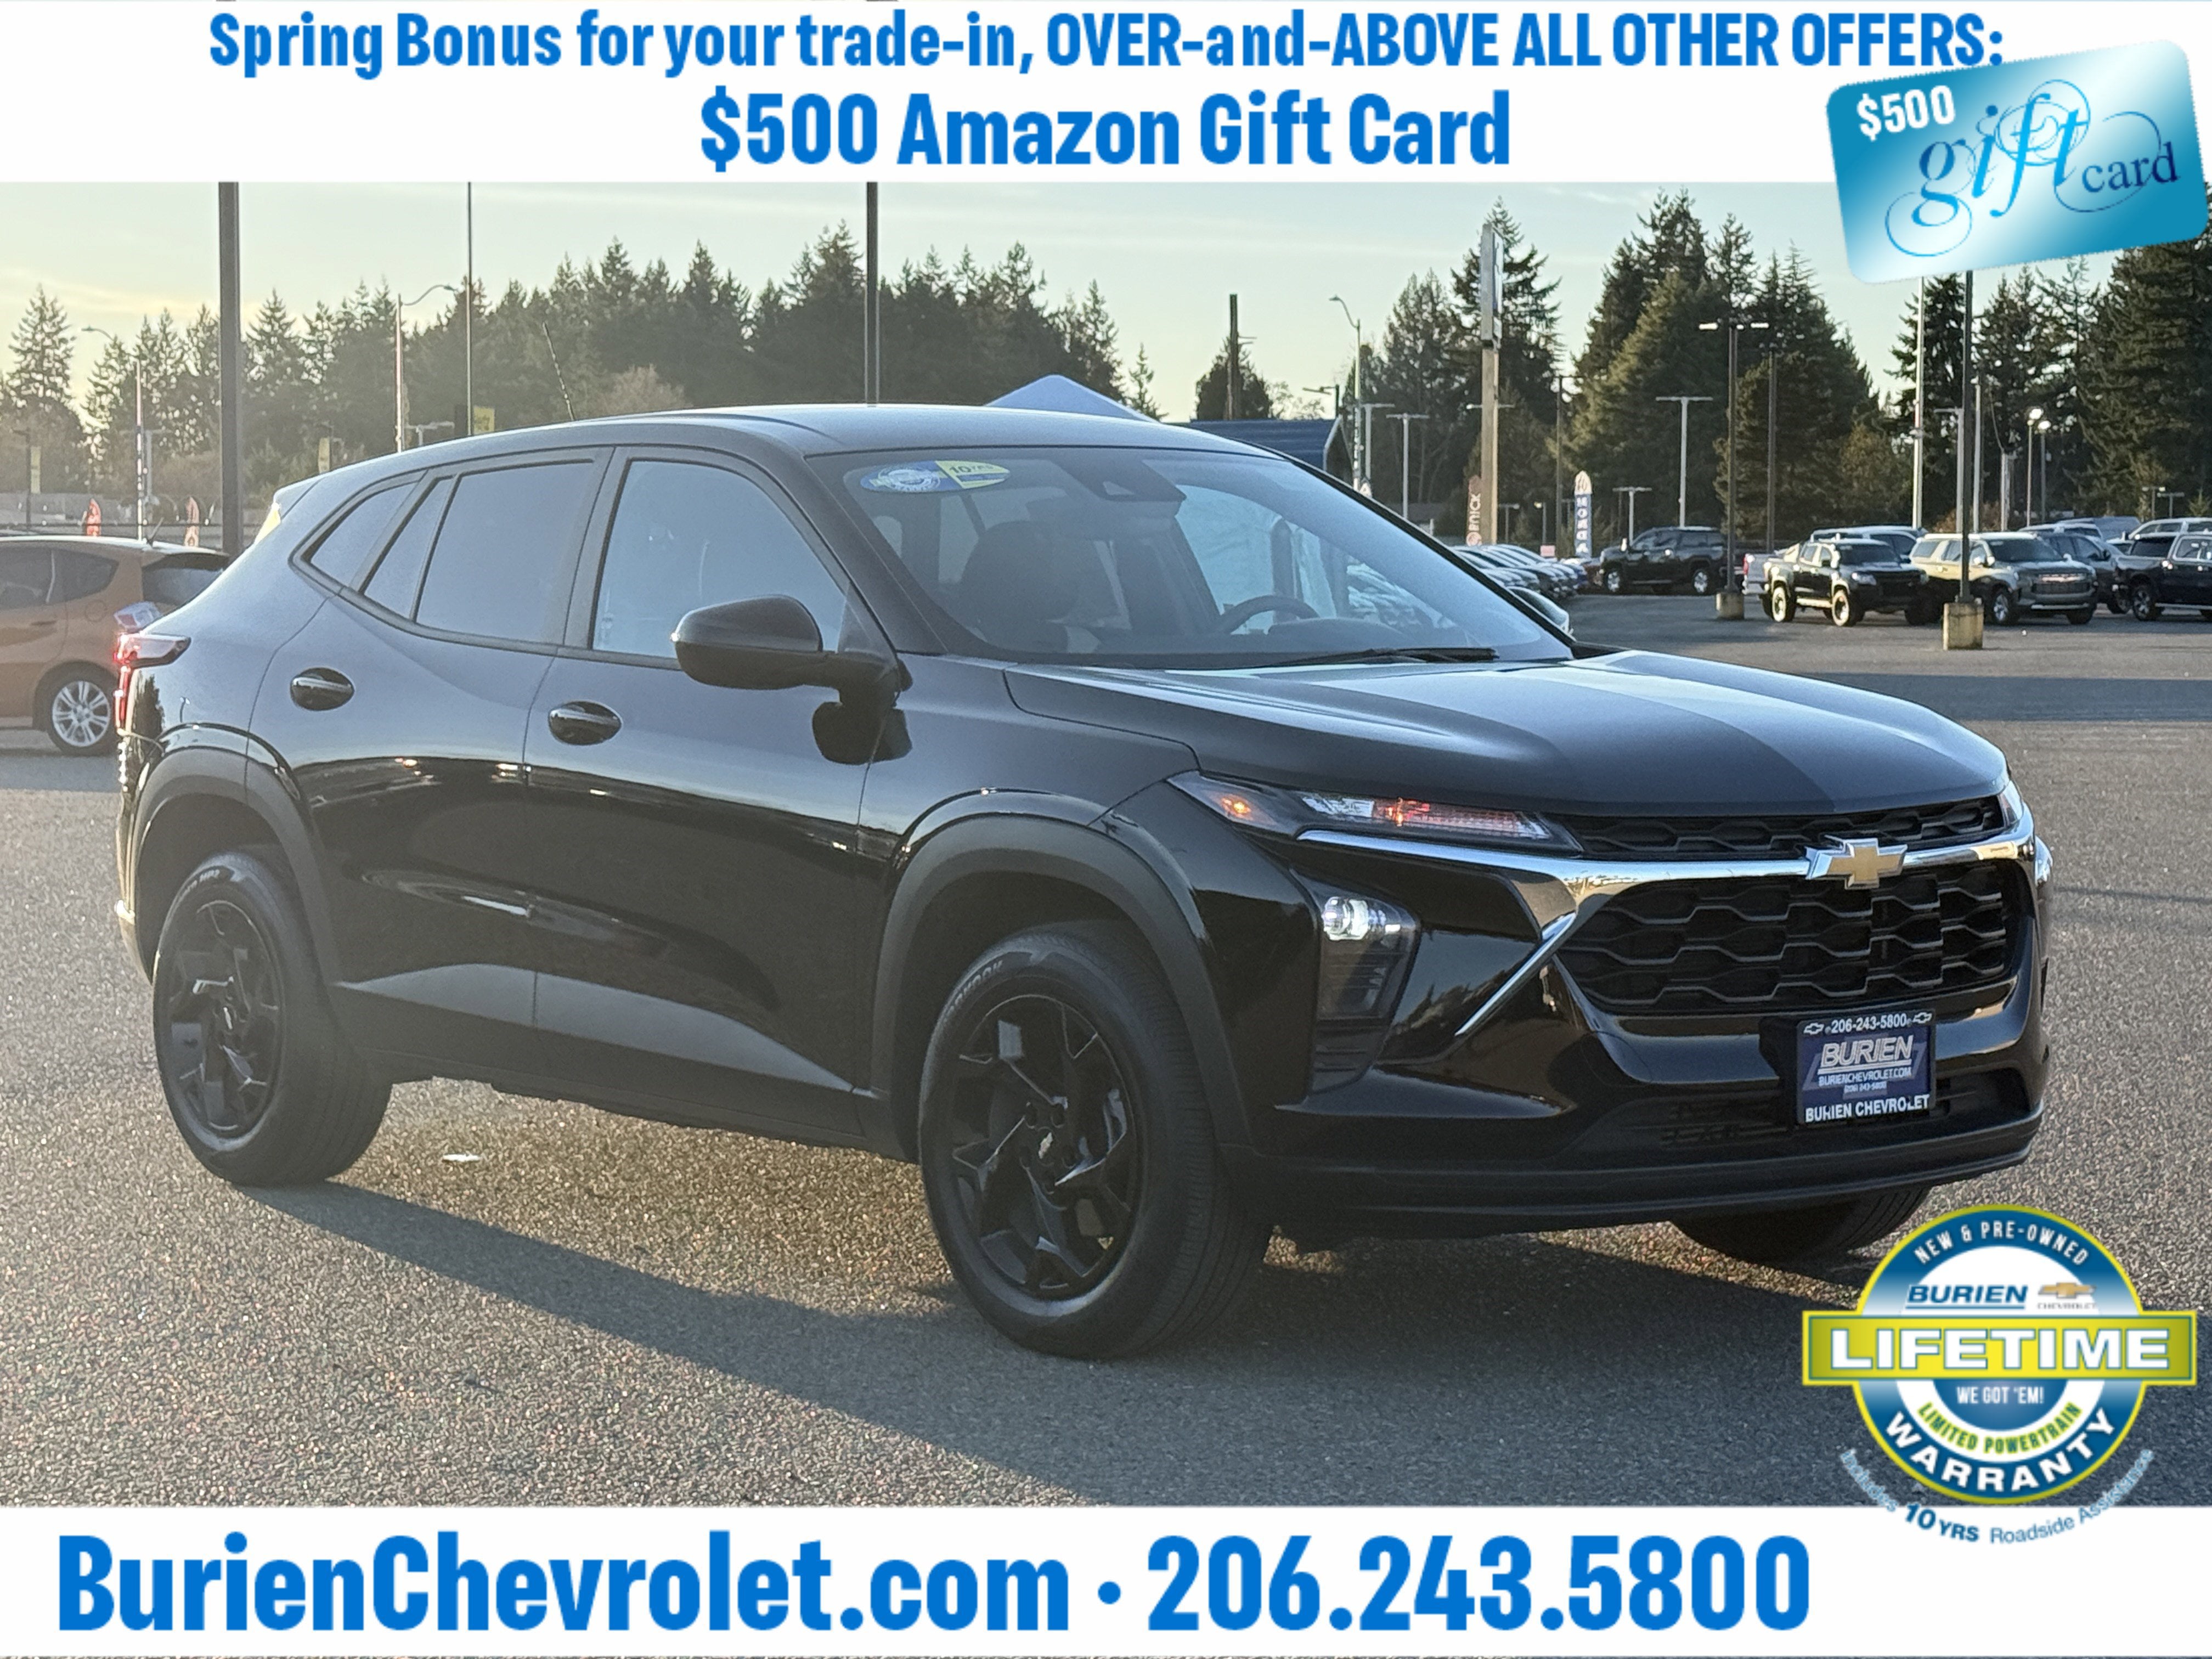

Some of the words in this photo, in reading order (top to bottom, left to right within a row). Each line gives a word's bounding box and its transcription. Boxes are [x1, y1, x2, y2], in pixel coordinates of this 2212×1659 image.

[1831, 1013, 1908, 1034] 206-243-5800
[1820, 1035, 1914, 1068] BURIEN
[1805, 1102, 1853, 1123] BURIEN
[1855, 1094, 1930, 1117] CHEVROLET
